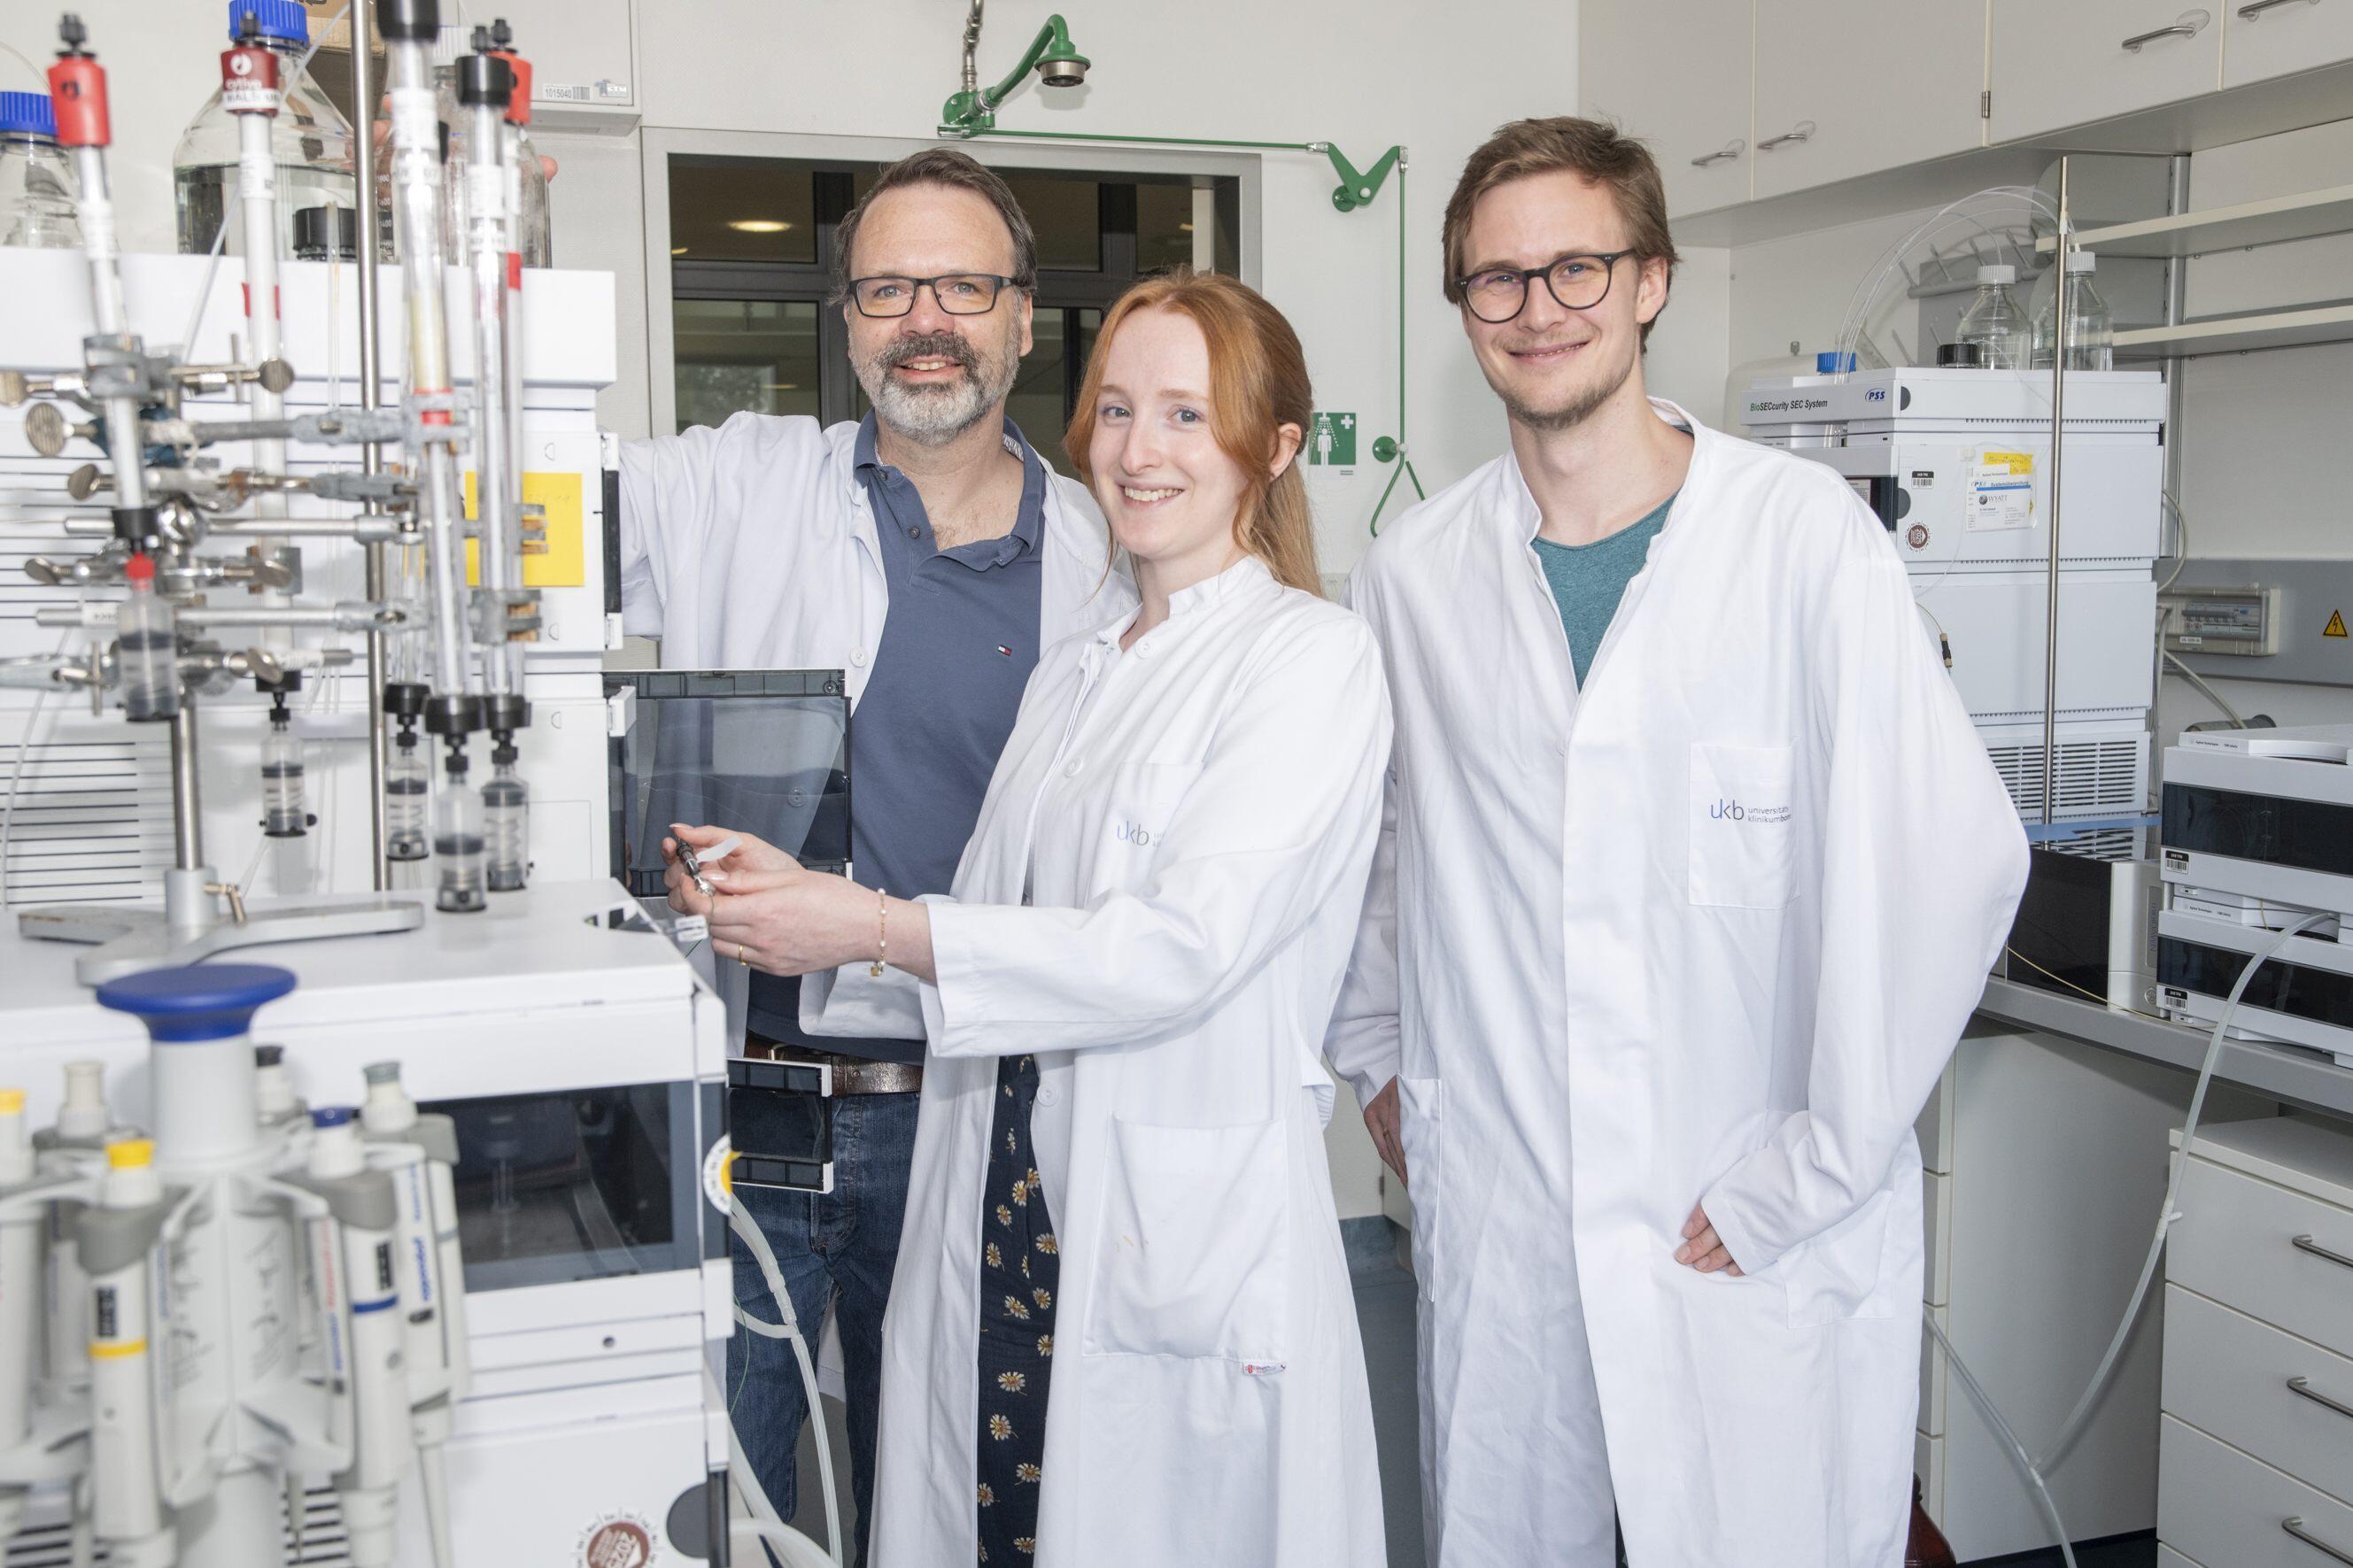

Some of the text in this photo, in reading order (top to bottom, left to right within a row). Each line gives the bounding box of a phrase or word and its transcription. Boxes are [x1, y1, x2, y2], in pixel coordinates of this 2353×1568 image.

[545, 88, 572, 99] 1015040
[1869, 390, 1885, 400] PSS
[1750, 399, 1828, 412] BioSECcurity SEC System
[1710, 798, 1745, 821] ukb
[1117, 820, 1149, 846] ukb
